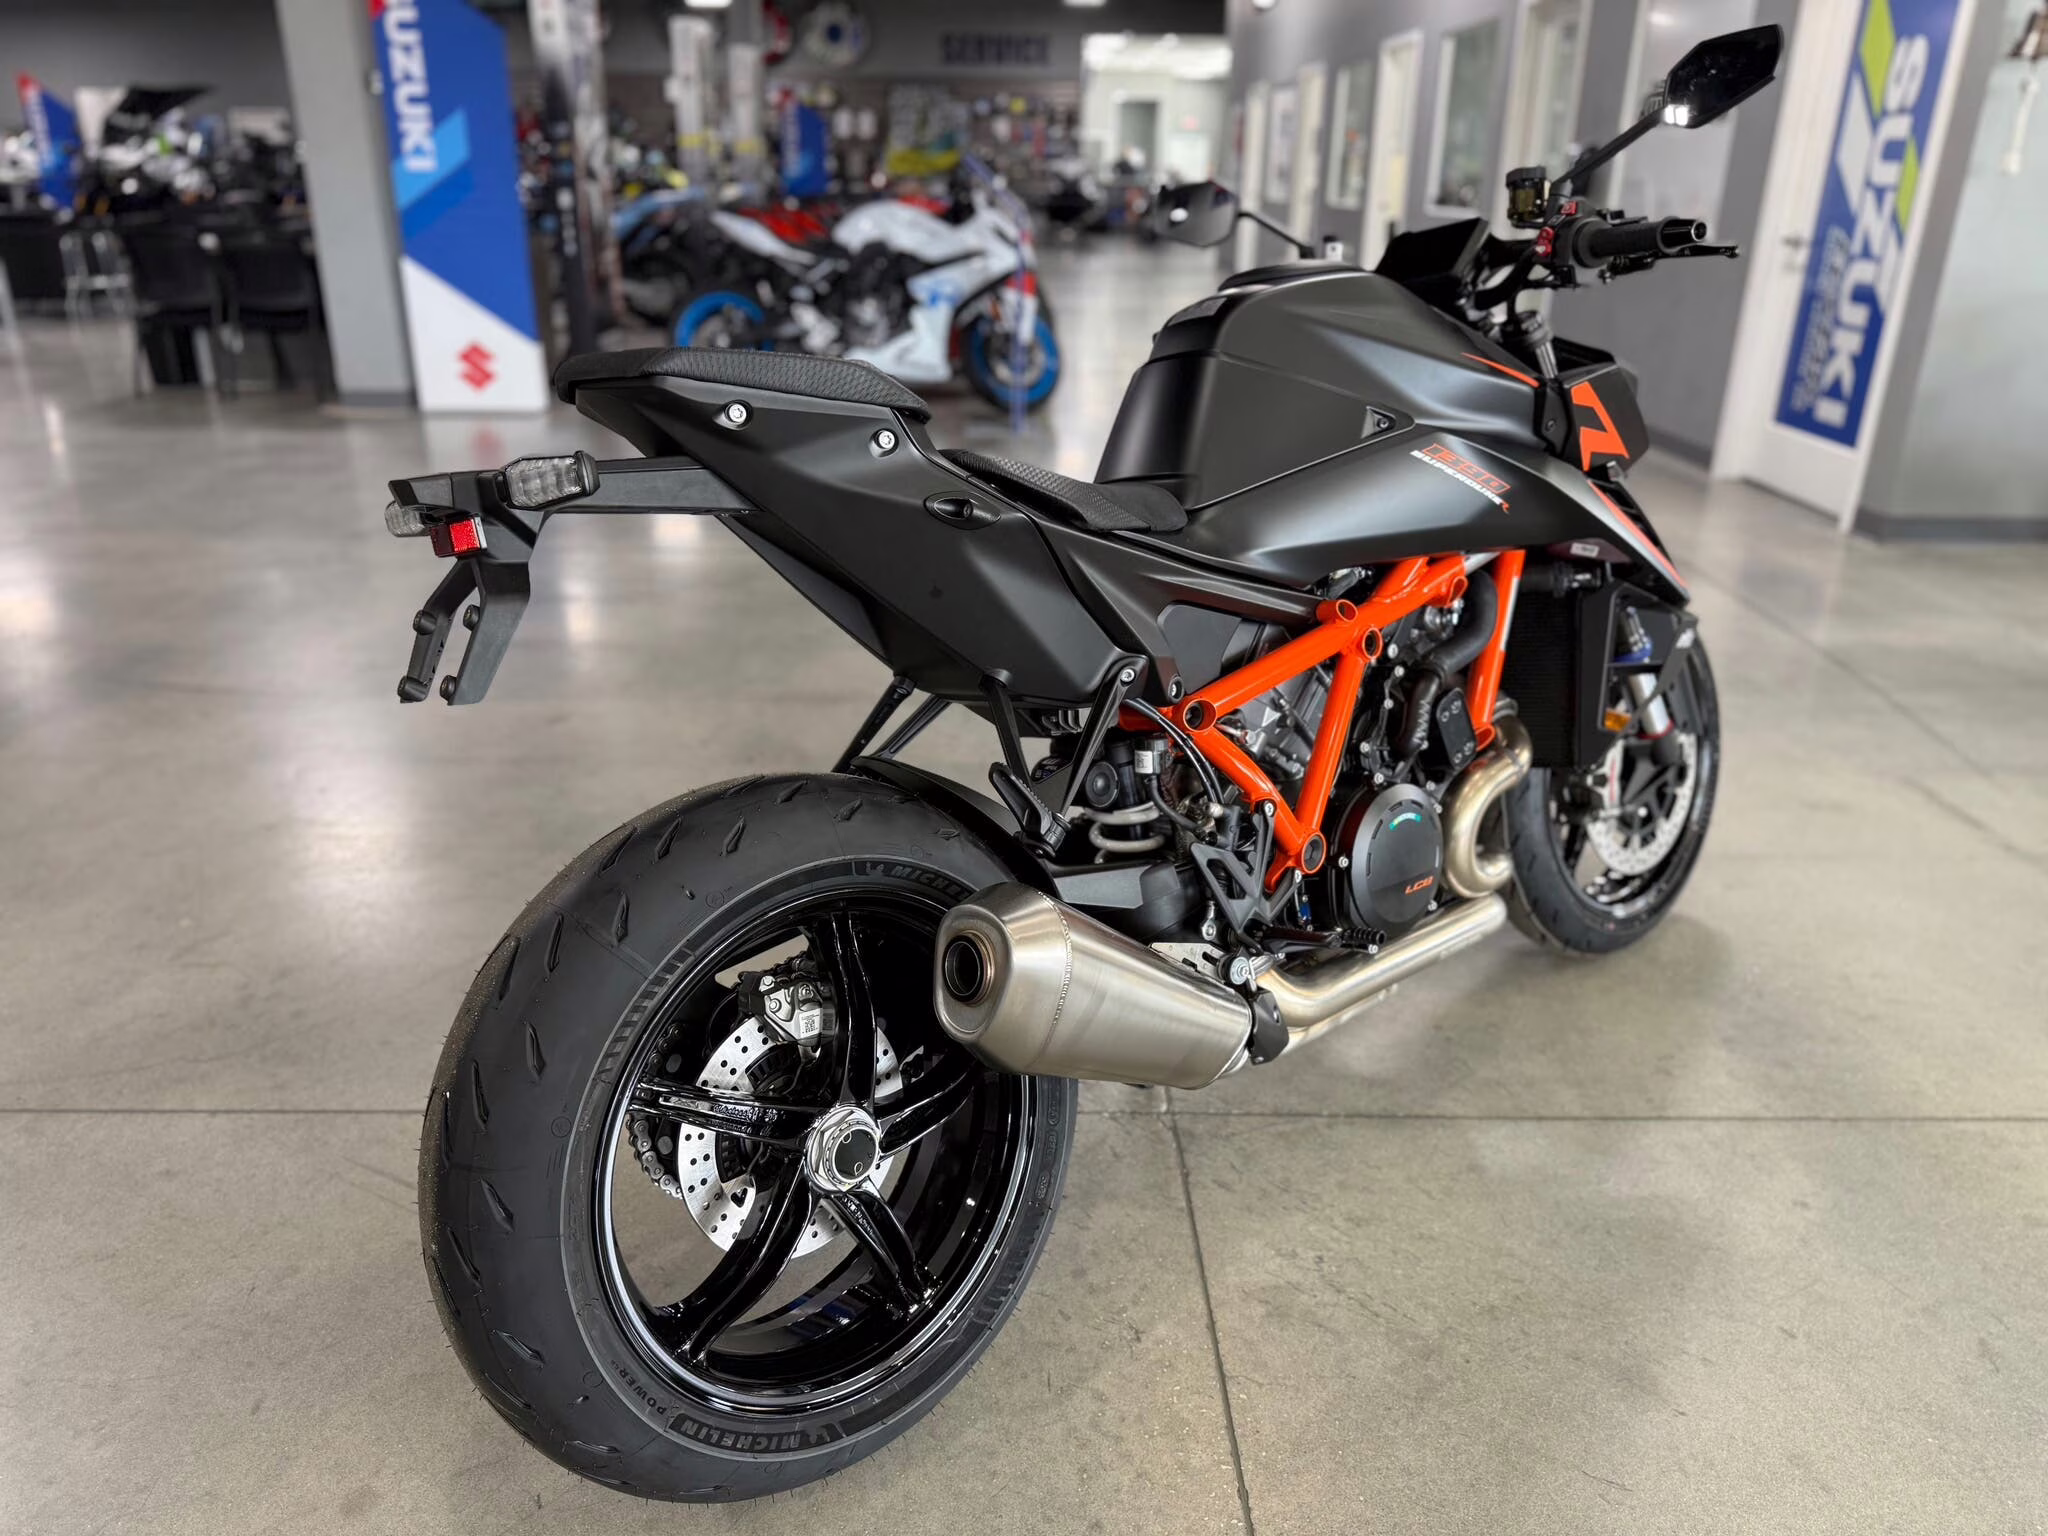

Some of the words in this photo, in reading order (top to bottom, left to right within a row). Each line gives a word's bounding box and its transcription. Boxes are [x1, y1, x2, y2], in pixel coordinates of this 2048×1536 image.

[383, 0, 438, 172] UZUKI
[1812, 34, 1929, 429] SUZUKI
[891, 866, 972, 901] MICHE
[619, 1368, 667, 1416] POWER
[679, 1419, 799, 1451] MICHELIN
